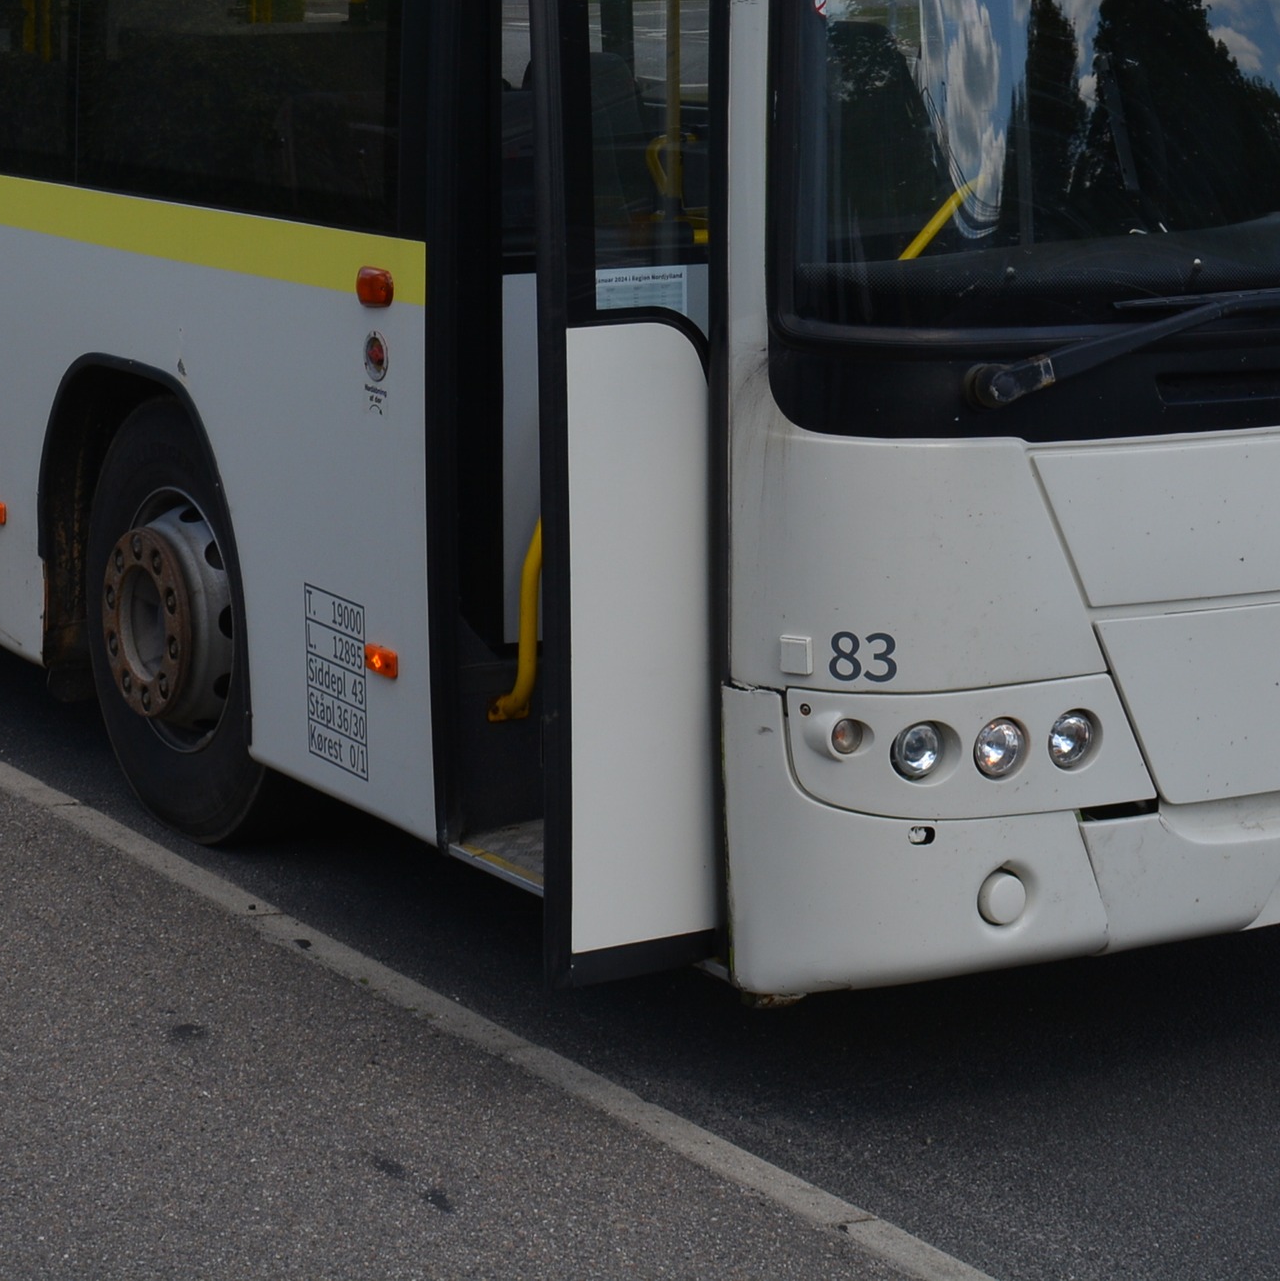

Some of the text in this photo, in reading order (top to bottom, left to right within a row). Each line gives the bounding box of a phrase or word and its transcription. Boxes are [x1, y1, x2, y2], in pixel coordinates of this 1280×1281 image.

[306, 590, 362, 635] T. 19000
[307, 624, 363, 670] L. 12895
[828, 630, 898, 684] 83
[308, 658, 364, 705] Siddepl 43
[308, 693, 365, 740] Ståpl 36/30
[309, 725, 366, 774] Kørest 0/1
